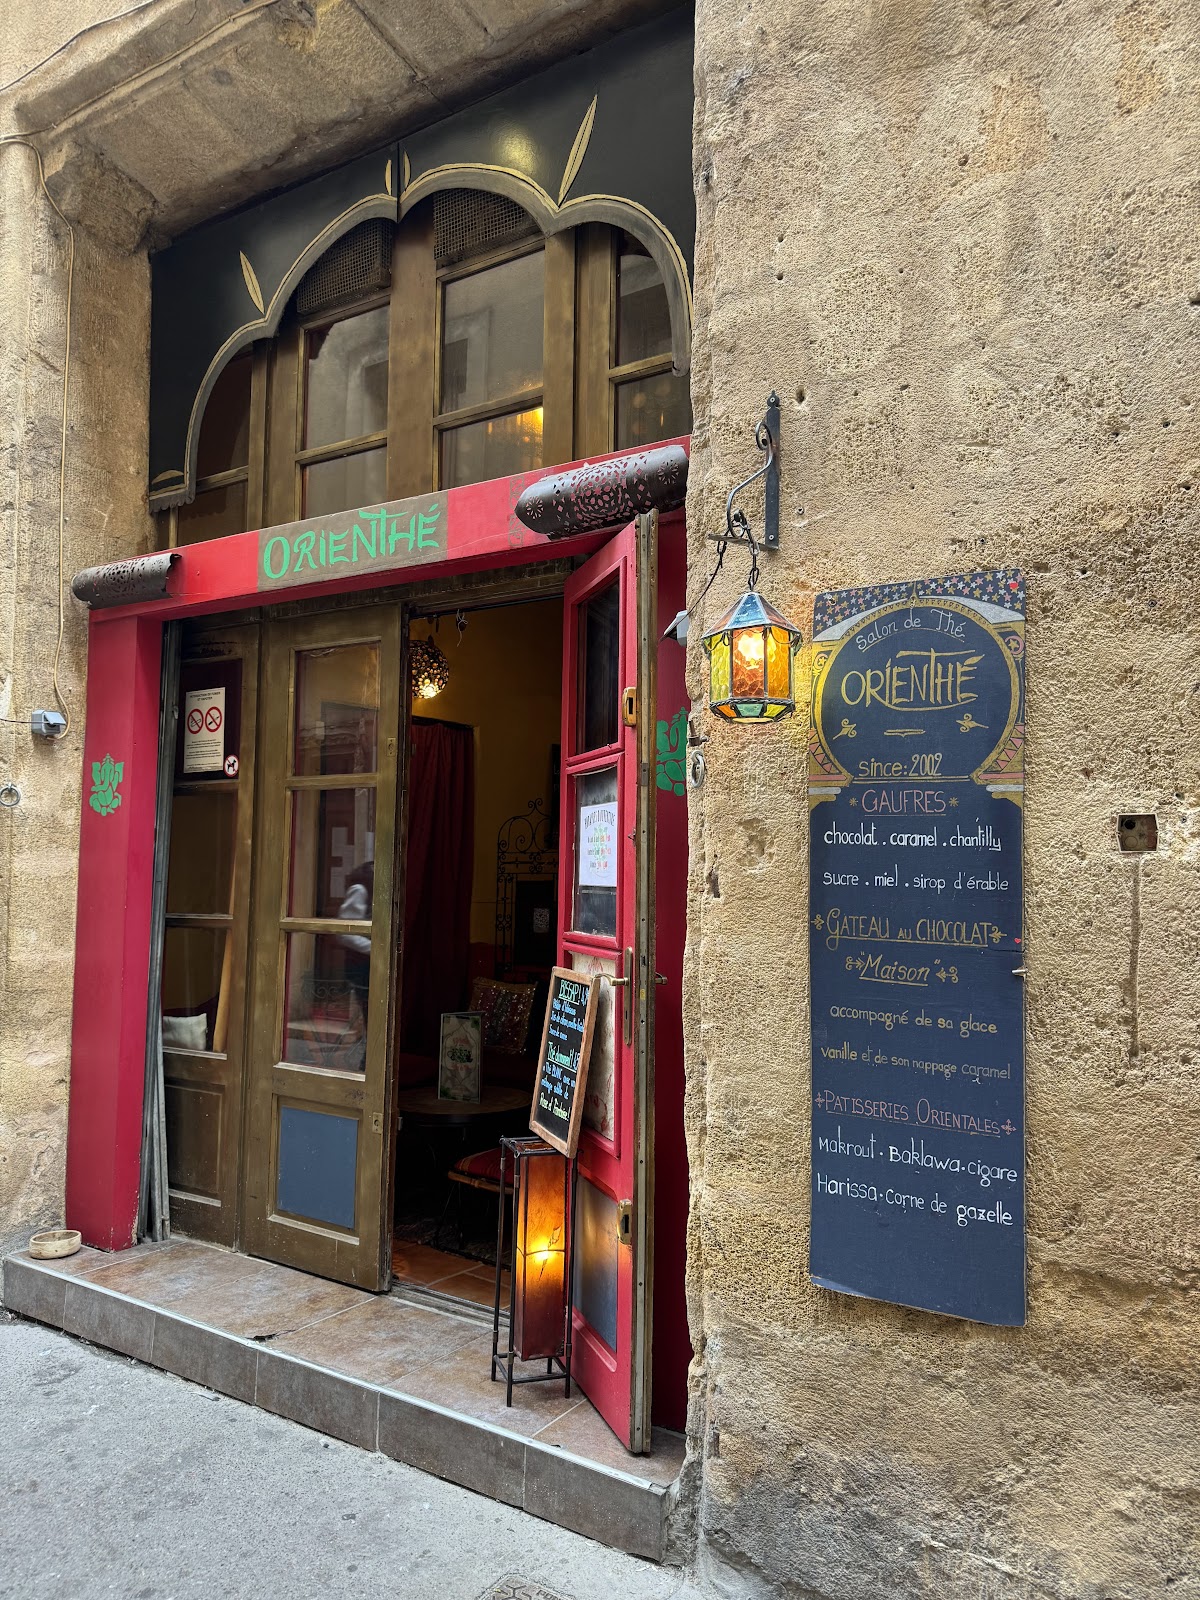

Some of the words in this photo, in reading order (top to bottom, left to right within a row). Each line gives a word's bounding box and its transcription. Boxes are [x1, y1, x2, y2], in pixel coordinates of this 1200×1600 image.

[856, 621, 898, 650] Salon
[904, 612, 921, 628] de
[931, 608, 965, 638] Thé
[861, 790, 946, 813] GAUFRES
[824, 821, 877, 845] chocolat
[890, 827, 937, 847] caramel
[950, 818, 1001, 851] chantilly
[823, 871, 859, 885] sucre
[874, 864, 898, 887] miel
[913, 874, 946, 894] sirop
[953, 871, 1009, 890] d'érable
[826, 908, 889, 950] GATEAU
[897, 927, 912, 940] AU
[916, 918, 992, 945] CHOCOLAT
[830, 1005, 909, 1031] accompagné
[915, 1009, 932, 1026] de
[938, 1018, 953, 1029] sa
[960, 1013, 998, 1038] glace
[821, 1041, 858, 1061] vanille
[861, 1046, 873, 1062] et
[874, 1049, 888, 1064] de
[891, 1055, 910, 1067] son
[912, 1060, 957, 1080] nappage
[961, 1063, 1011, 1079] caramel
[824, 1089, 909, 1121] PATISSERIES
[915, 1098, 1000, 1135] ORIENTALES
[967, 1159, 1018, 1188] cigare
[817, 1172, 878, 1201] Harissa
[930, 1193, 948, 1214] de
[956, 1201, 1014, 1227] gazelle
